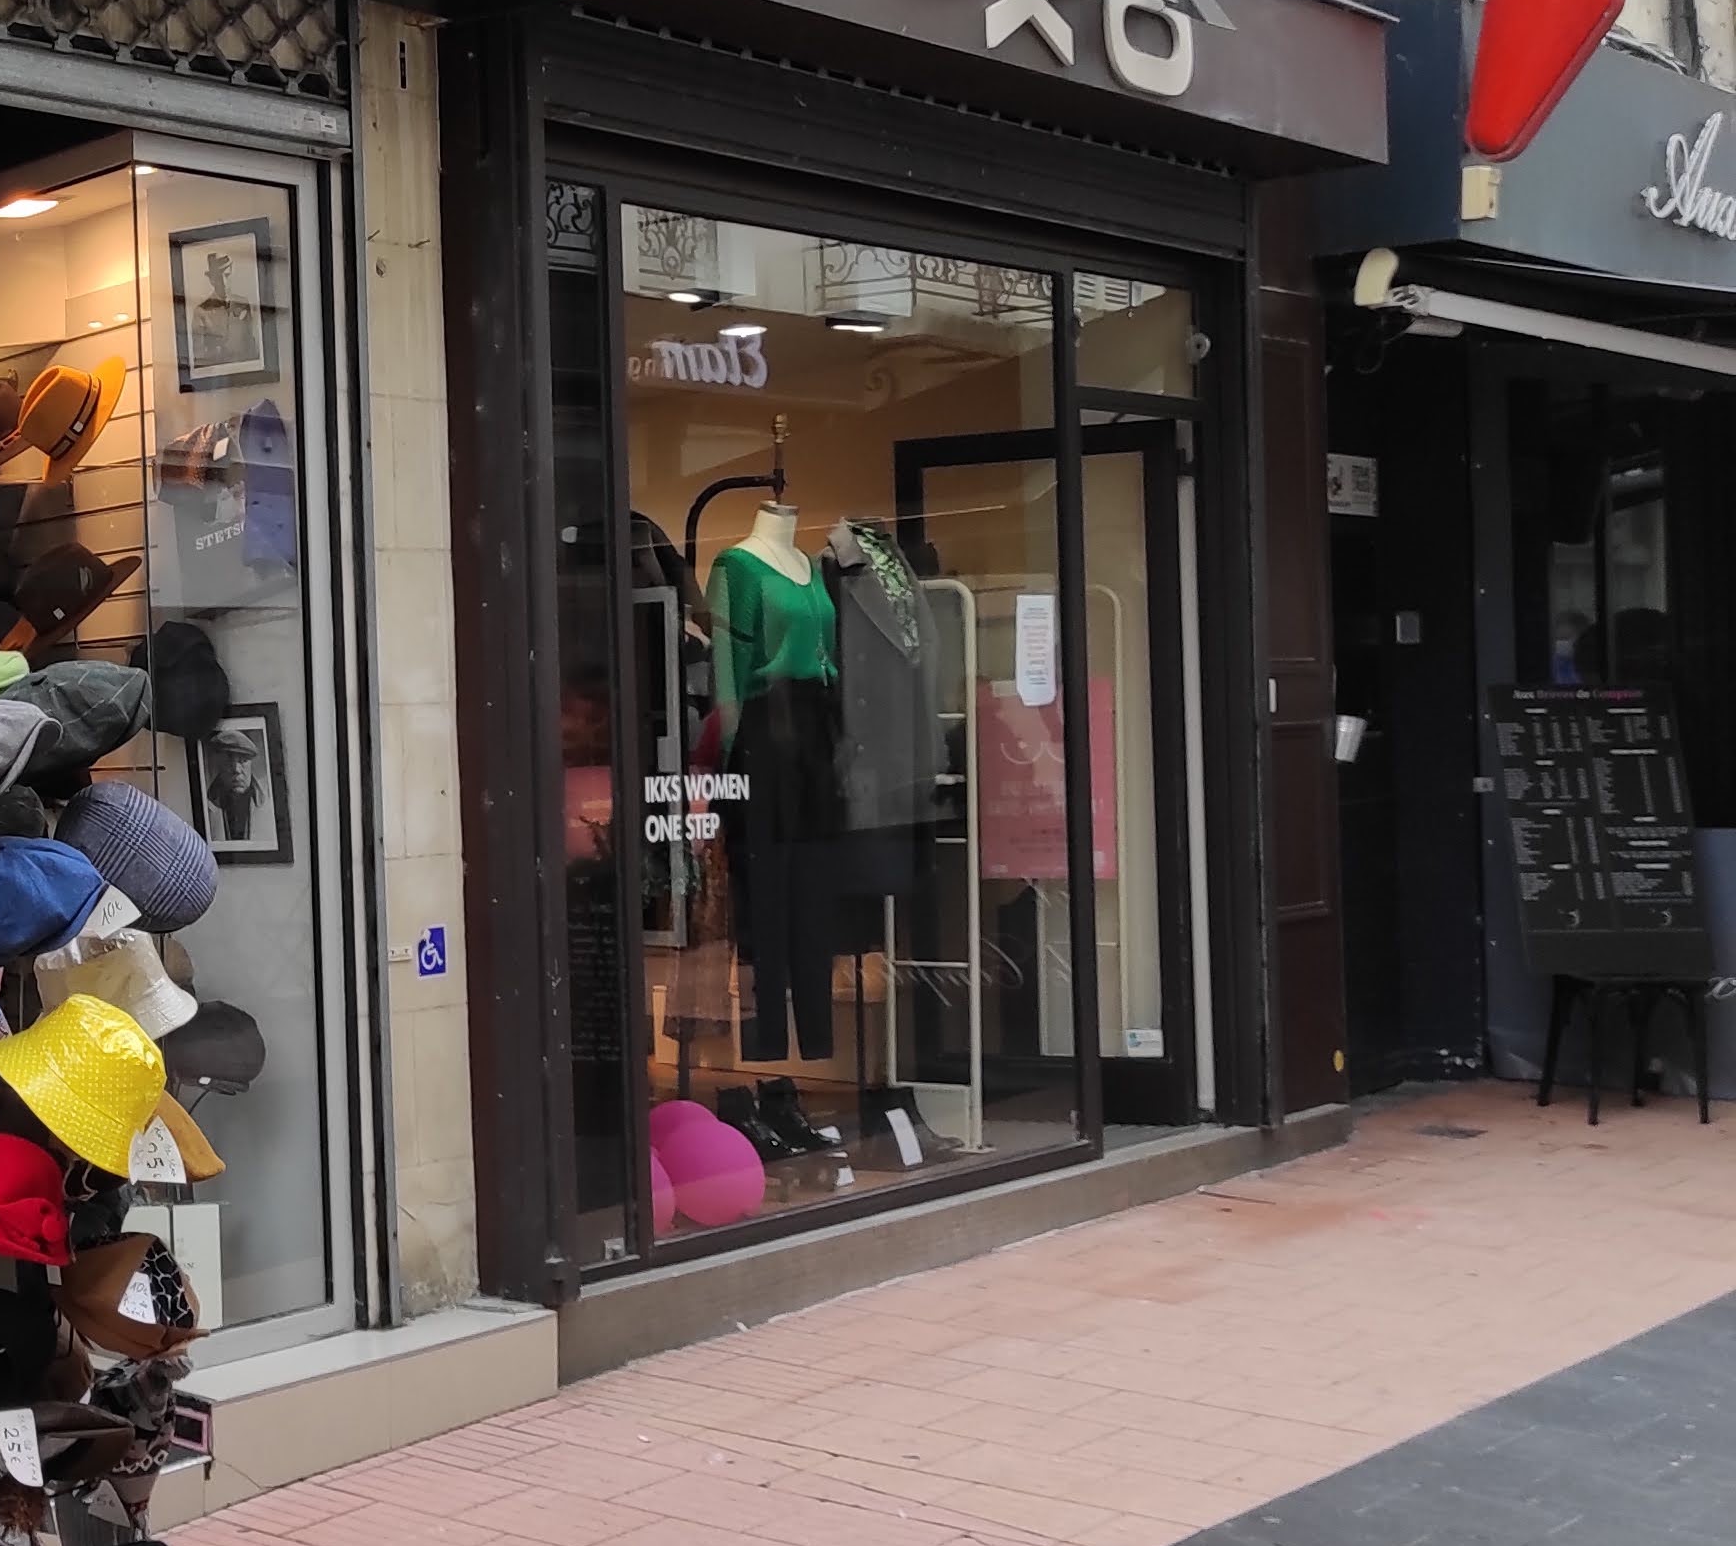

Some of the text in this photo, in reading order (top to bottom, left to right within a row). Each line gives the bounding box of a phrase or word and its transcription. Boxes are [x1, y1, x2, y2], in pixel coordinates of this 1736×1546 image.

[195, 520, 246, 551] STETS
[644, 772, 750, 804] IKKS WOMEN
[645, 812, 720, 843] ONE STEP
